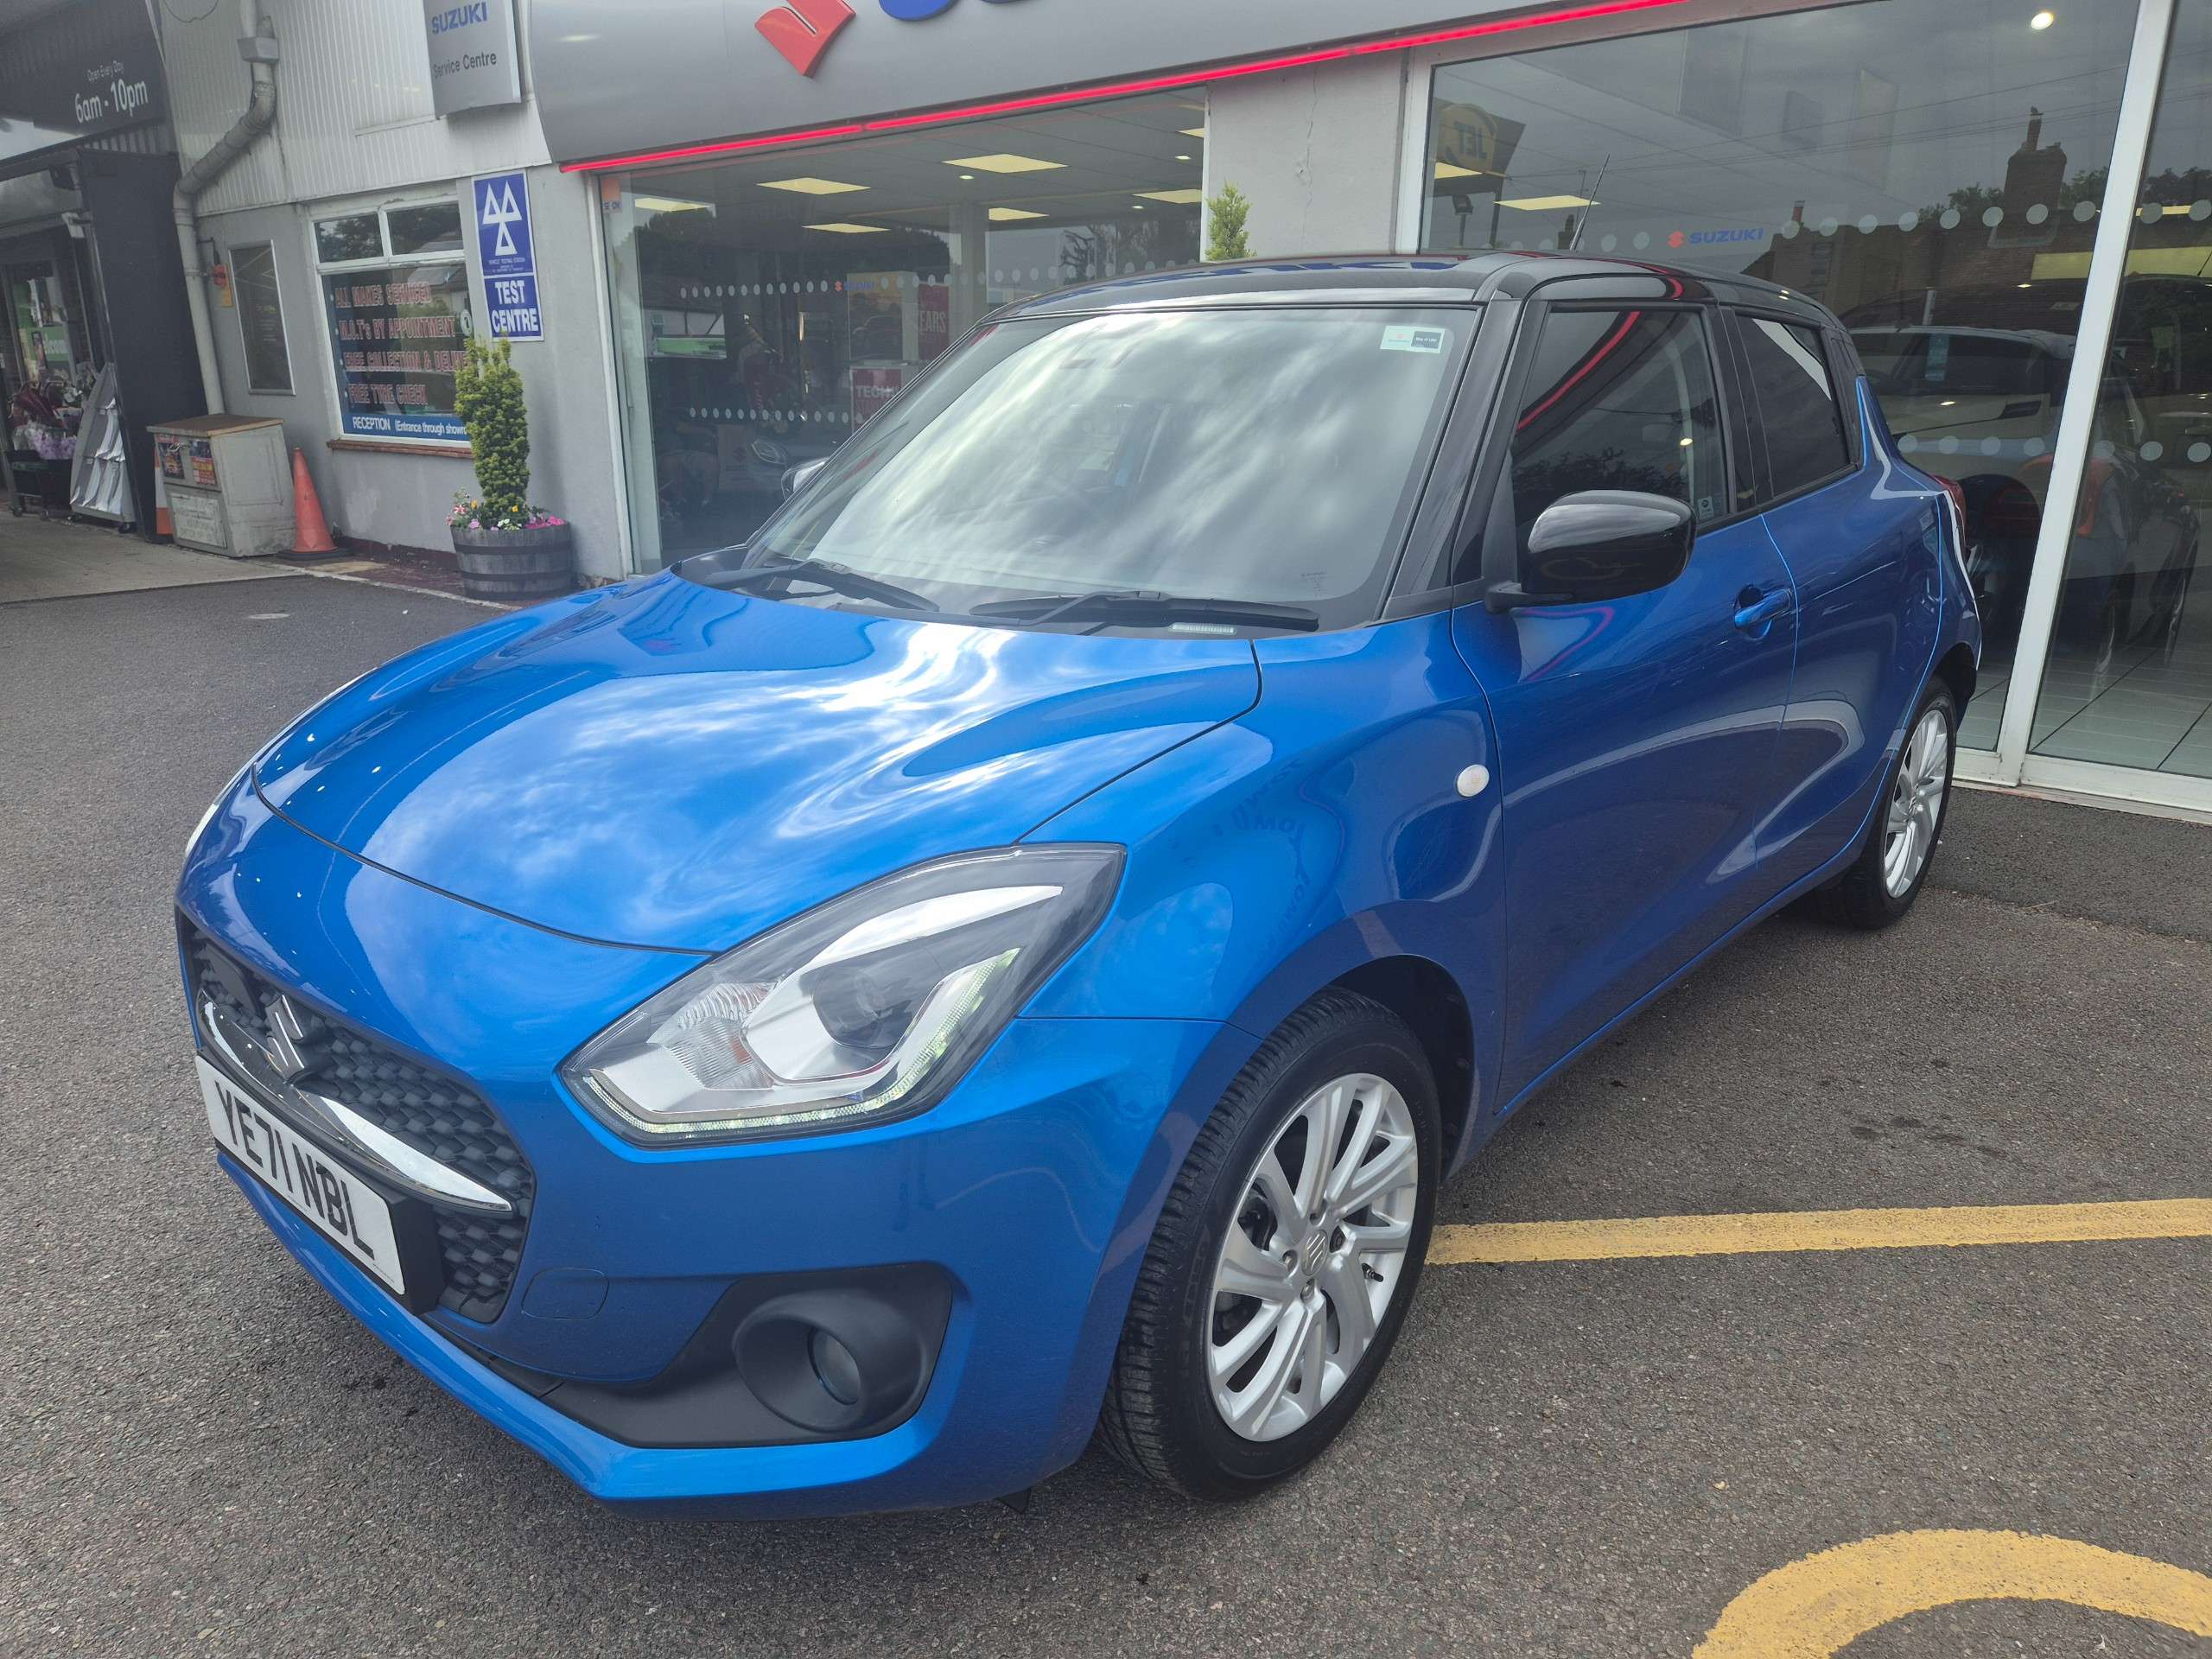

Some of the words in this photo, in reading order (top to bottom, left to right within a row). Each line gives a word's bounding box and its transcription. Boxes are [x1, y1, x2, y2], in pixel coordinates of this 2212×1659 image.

[432, 2, 487, 35] SUZUKI
[462, 52, 497, 69] Centre
[75, 92, 103, 123] 6am
[111, 79, 148, 118] 10pm
[1688, 227, 1764, 245] SUZUKI
[335, 288, 352, 308] ALL
[352, 285, 384, 307] MAKES
[494, 280, 525, 304] TEST
[372, 318, 385, 340] BY
[389, 315, 456, 339] APPOINTMENT
[491, 308, 540, 333] CENTRE
[366, 351, 421, 372] COLLECTION
[434, 350, 471, 372] DELIVE
[348, 384, 371, 404] FREE
[353, 416, 391, 430] RECEPTION
[422, 422, 444, 435] through
[446, 423, 468, 435] showro
[215, 1081, 294, 1193] YE71
[292, 1142, 375, 1260] NBL
